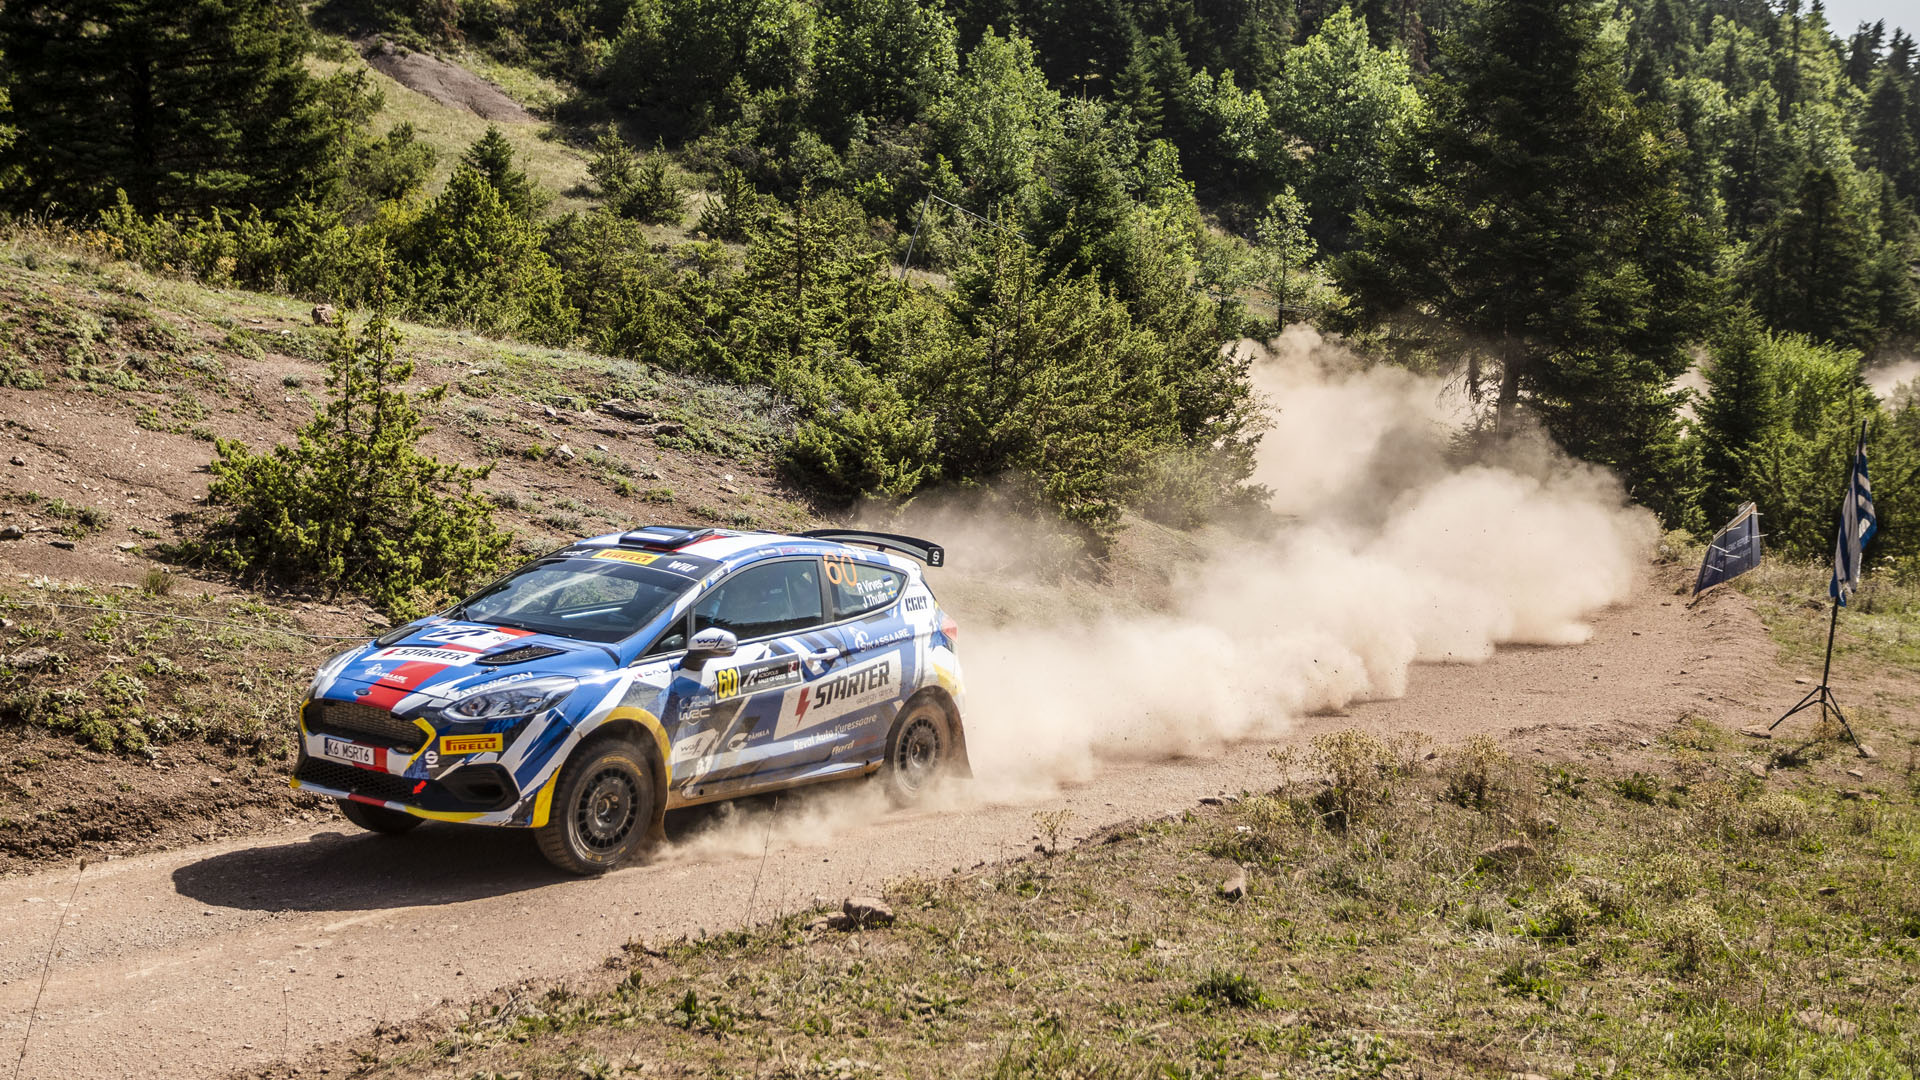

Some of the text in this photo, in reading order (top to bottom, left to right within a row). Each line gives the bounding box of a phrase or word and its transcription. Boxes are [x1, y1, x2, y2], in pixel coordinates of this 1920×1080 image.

[600, 551, 653, 563] PIRELLI
[823, 551, 857, 587] 60
[856, 579, 884, 595] R Virves
[863, 590, 888, 609] J Thulin
[395, 648, 470, 661] STARTER
[717, 668, 739, 698] 60
[813, 660, 890, 710] STARTER
[679, 708, 711, 720] WRC
[815, 729, 834, 742] Auto
[328, 741, 370, 762] K6 MSRT6
[445, 737, 497, 752] PIRELLI
